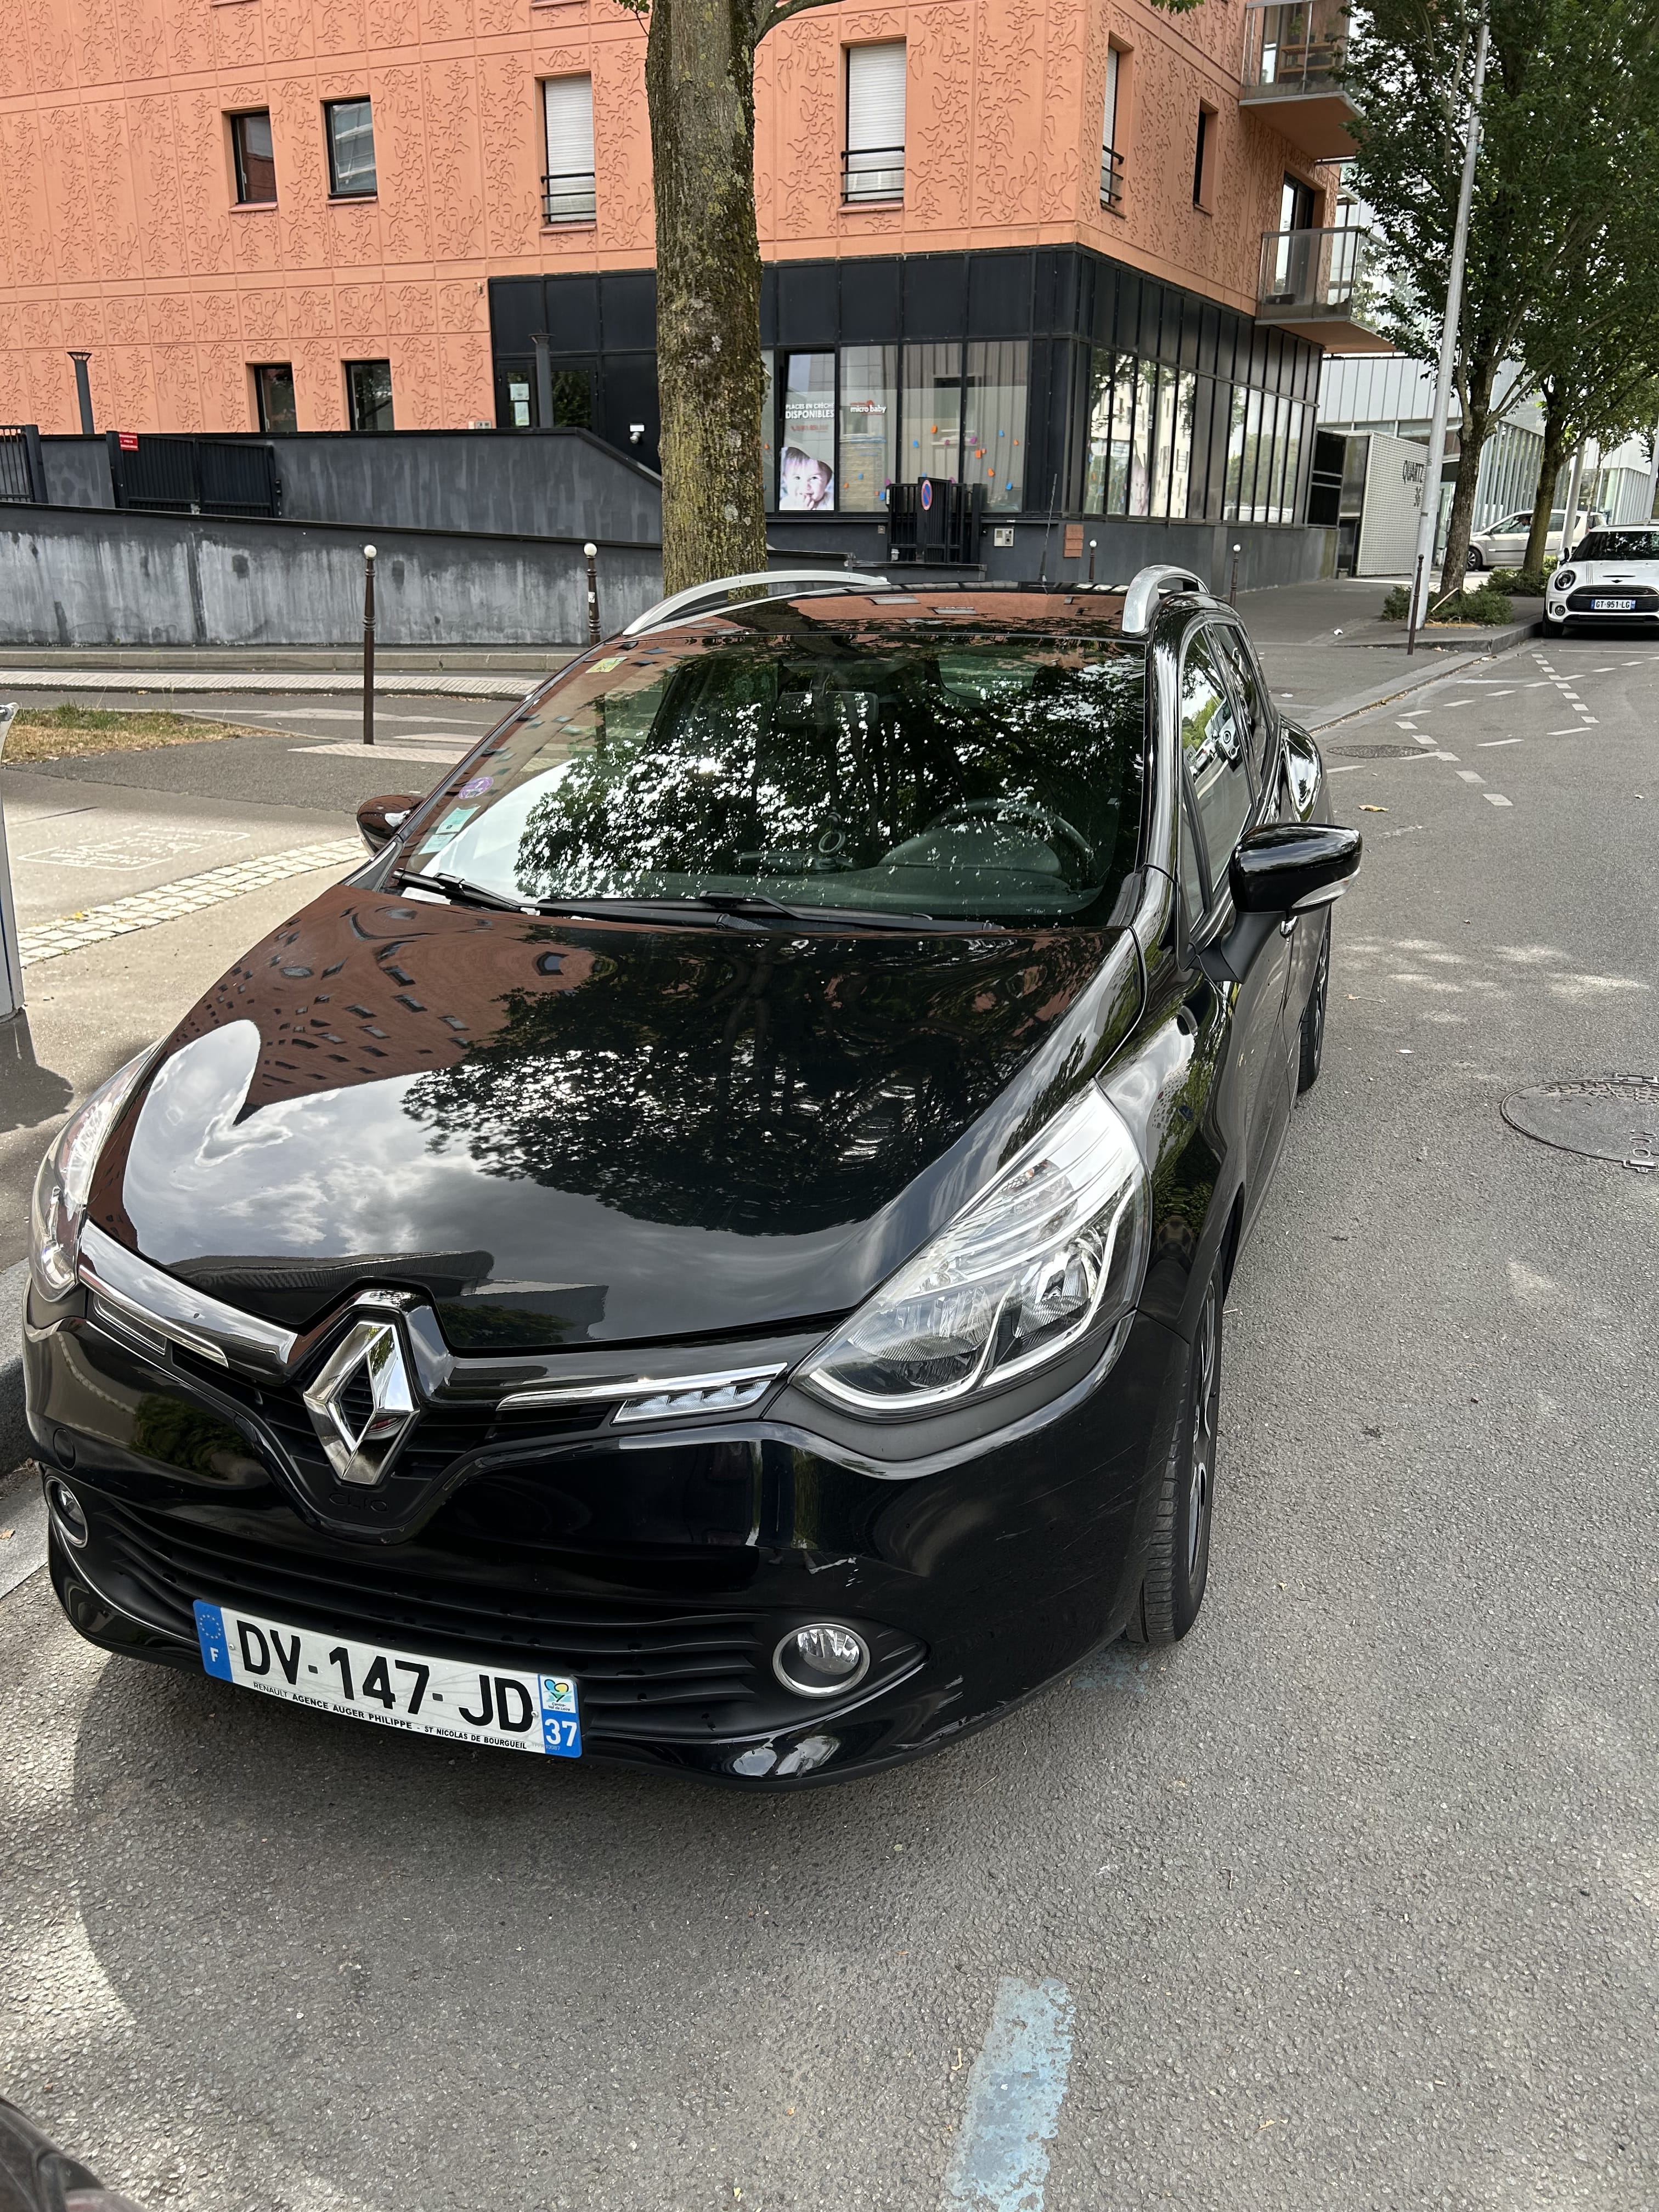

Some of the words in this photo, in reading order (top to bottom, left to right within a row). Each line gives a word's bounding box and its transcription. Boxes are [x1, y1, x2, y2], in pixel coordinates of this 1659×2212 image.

[785, 409, 834, 419] DISPONIBLES
[869, 404, 887, 414] baby
[210, 1646, 219, 1662] F
[253, 1682, 288, 1698] RENAULT
[292, 1694, 329, 1709] AGENCE
[332, 1705, 365, 1719] AUGER
[368, 1713, 413, 1729] PHILIPPE
[436, 1728, 468, 1740] NICOLAS
[483, 1737, 527, 1750] BOURGUEIL
[544, 1718, 577, 1747] 37
